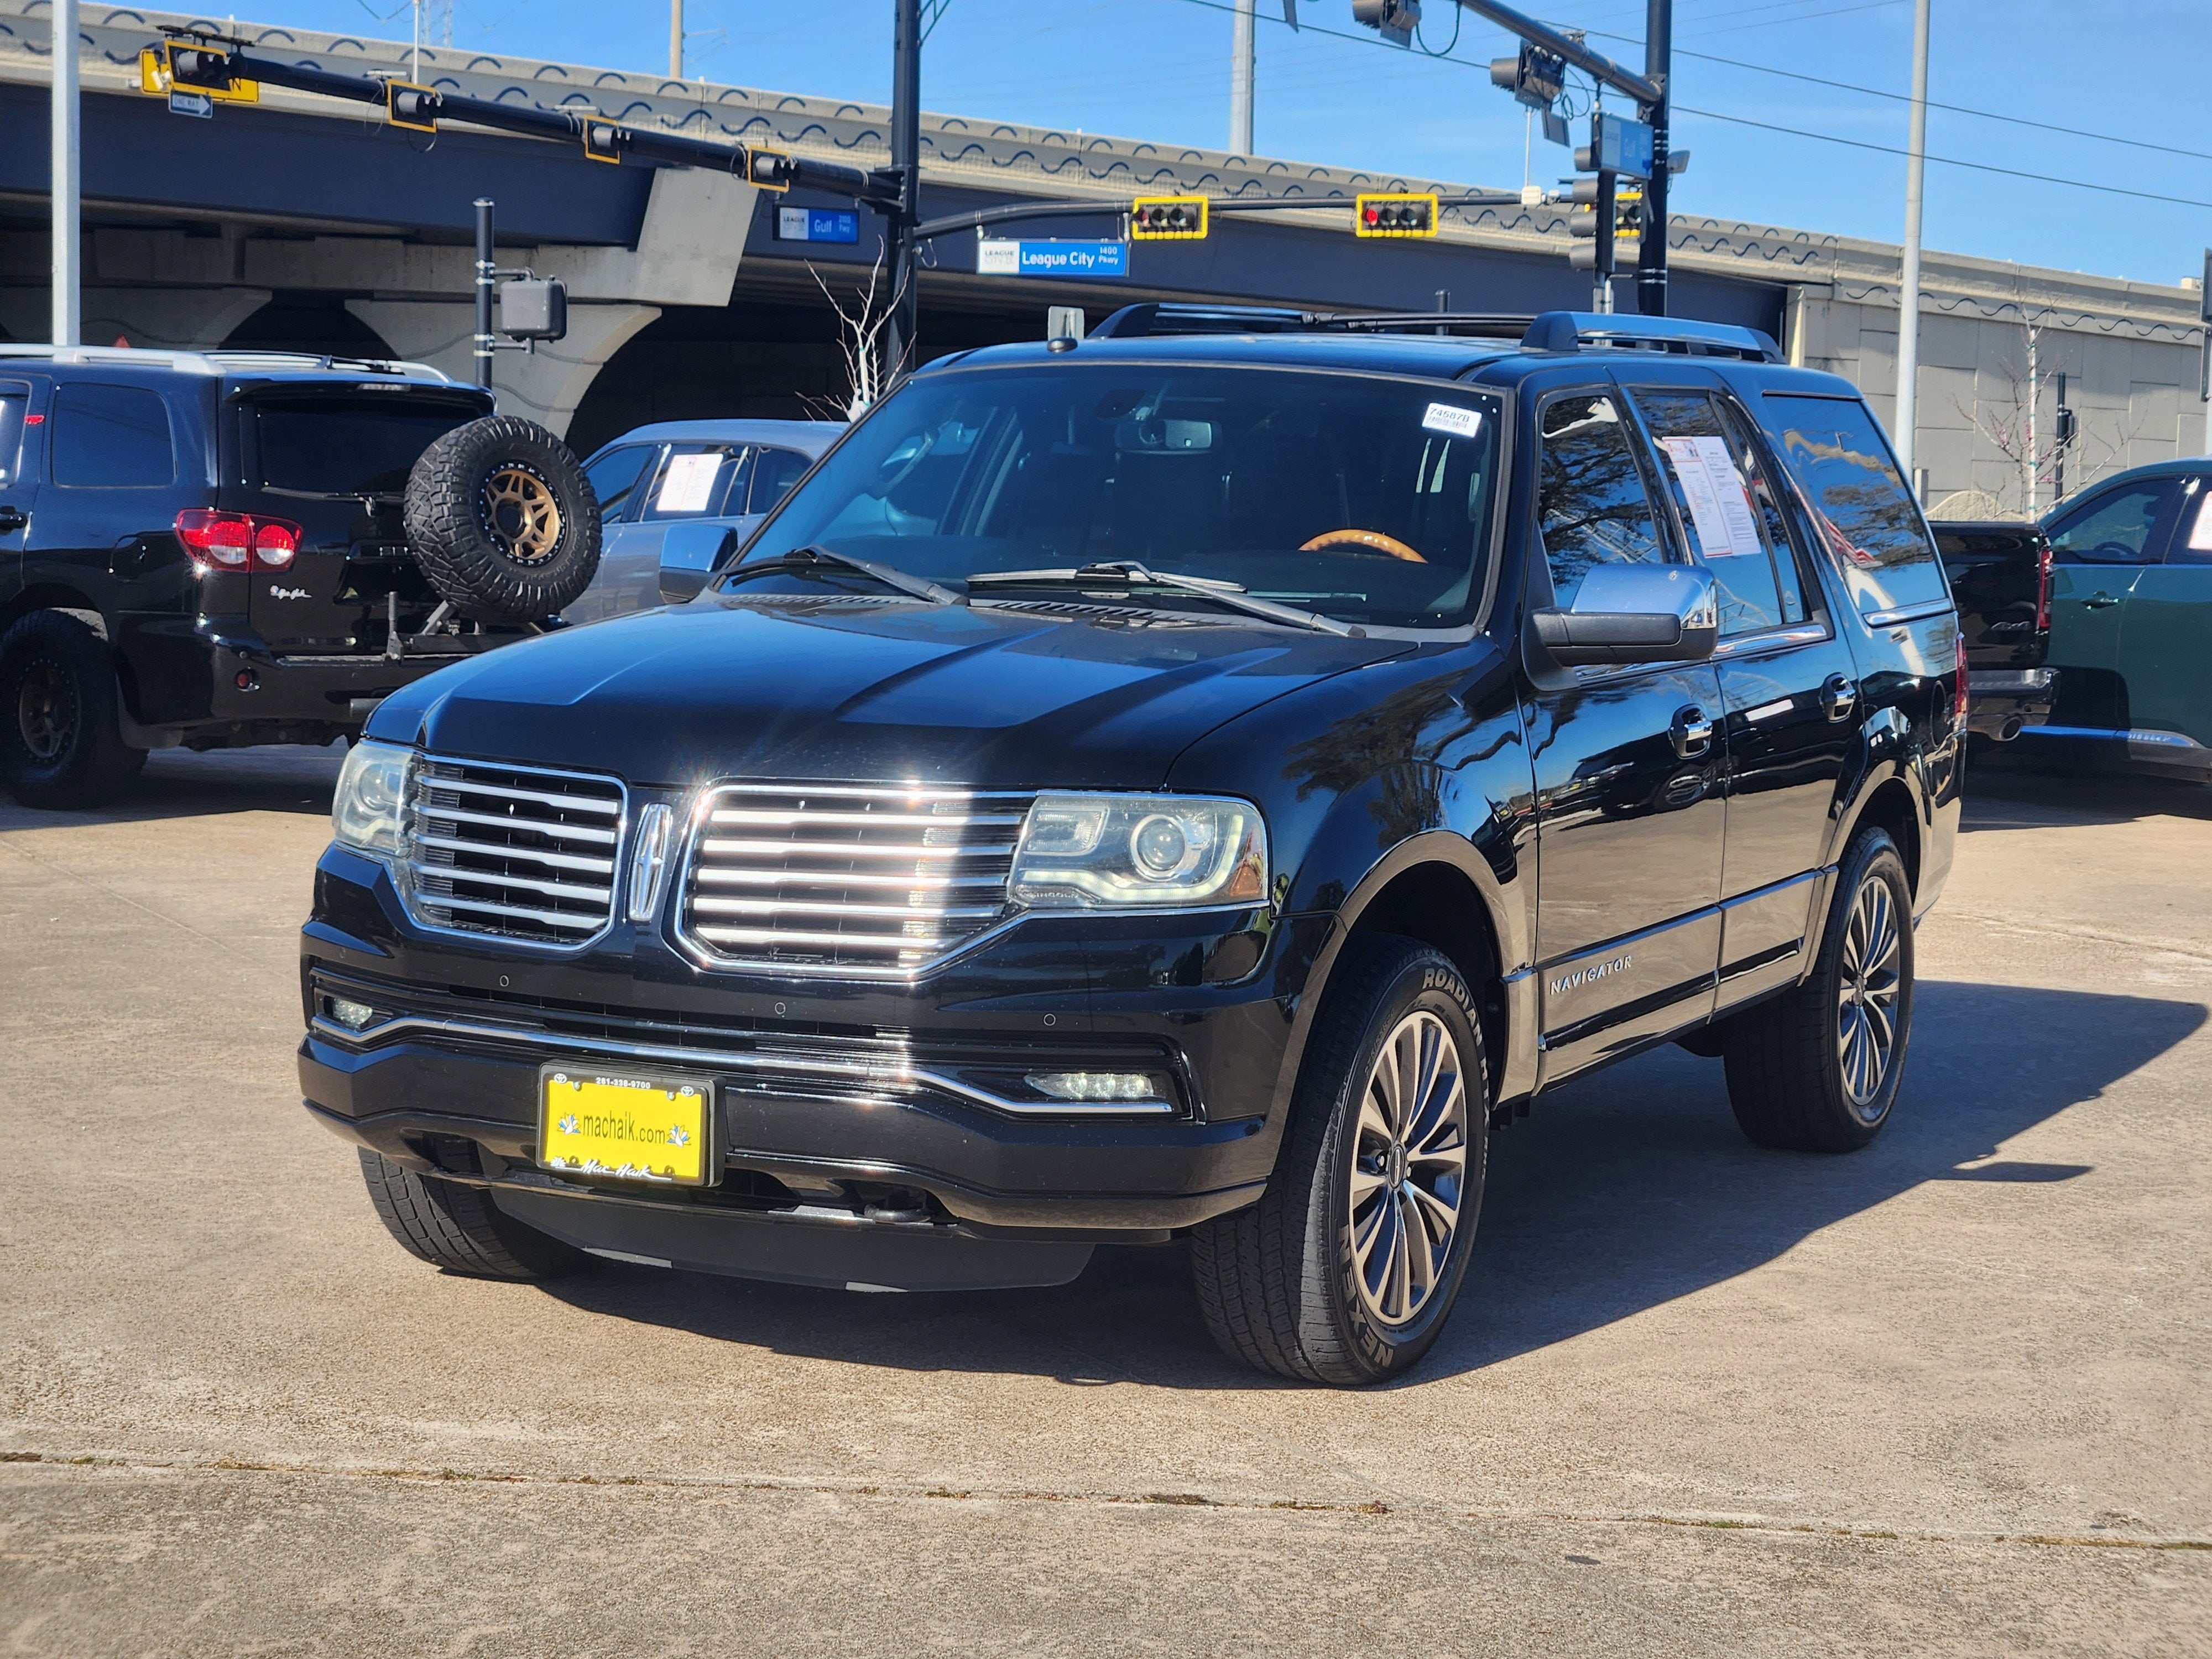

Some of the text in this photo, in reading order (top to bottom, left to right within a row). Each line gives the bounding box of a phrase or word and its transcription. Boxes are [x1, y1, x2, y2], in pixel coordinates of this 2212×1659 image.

[1022, 251, 1067, 268] League
[1070, 251, 1095, 268] City
[1550, 954, 1631, 996] NAVIGATOR
[1422, 968, 1483, 1047] ROADIAN
[596, 1077, 651, 1089] 281-338-9700
[583, 1110, 665, 1144] machaik.com
[580, 1158, 658, 1179] Mac Haik
[1338, 1224, 1394, 1368] NEXEN
